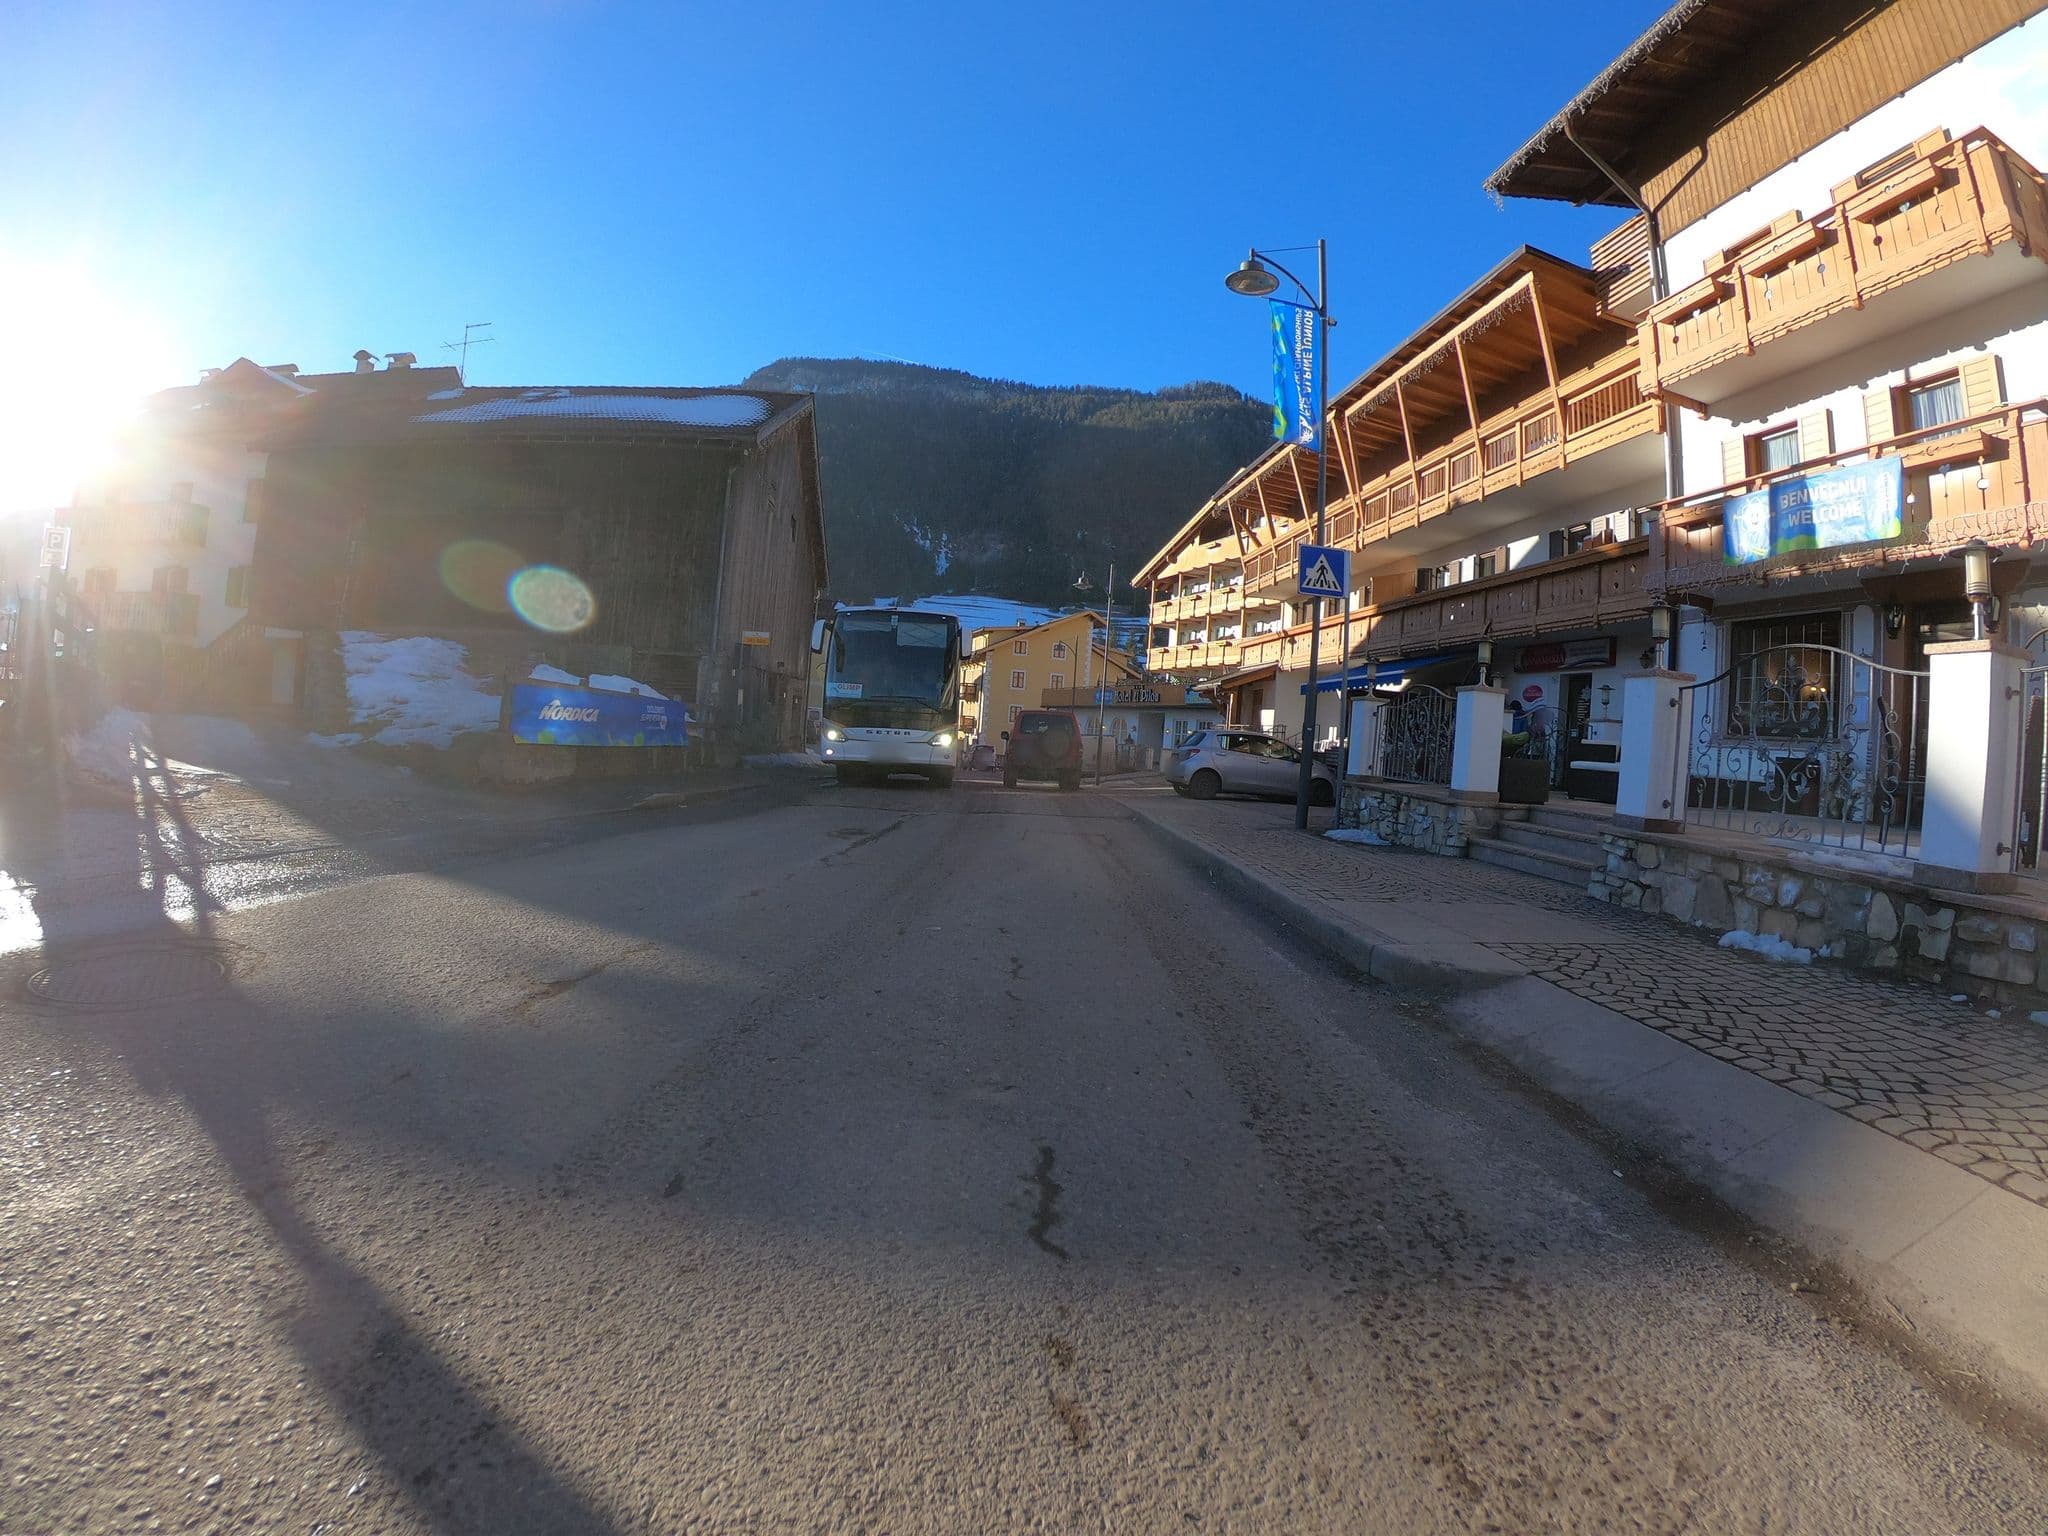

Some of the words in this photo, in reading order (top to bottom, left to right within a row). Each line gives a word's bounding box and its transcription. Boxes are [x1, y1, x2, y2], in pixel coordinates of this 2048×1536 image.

[1788, 500, 1862, 527] WELCOME
[50, 534, 61, 548] P
[538, 700, 600, 721] NORDICA
